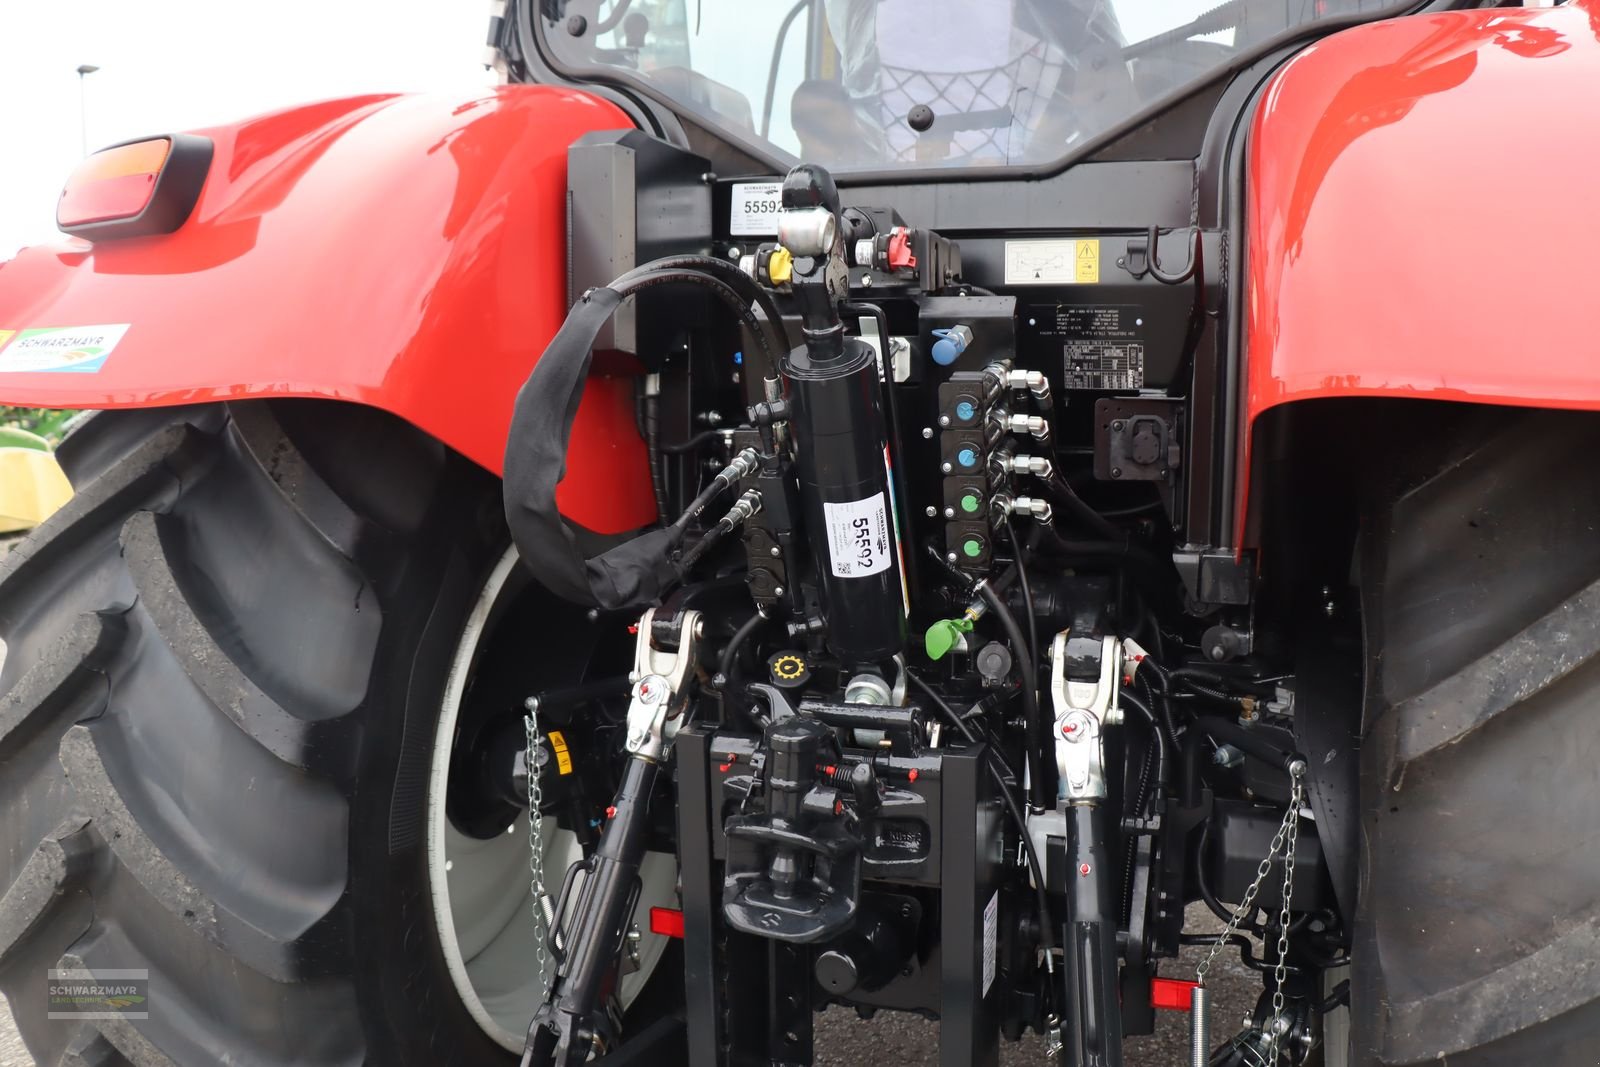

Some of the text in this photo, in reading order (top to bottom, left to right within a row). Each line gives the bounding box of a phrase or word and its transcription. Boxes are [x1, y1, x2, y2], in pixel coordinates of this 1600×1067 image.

[744, 200, 783, 213] 55592
[18, 336, 104, 348] SCHWARZMAYR
[852, 517, 873, 568] 55592
[878, 507, 887, 550] SCHWARZMAYR
